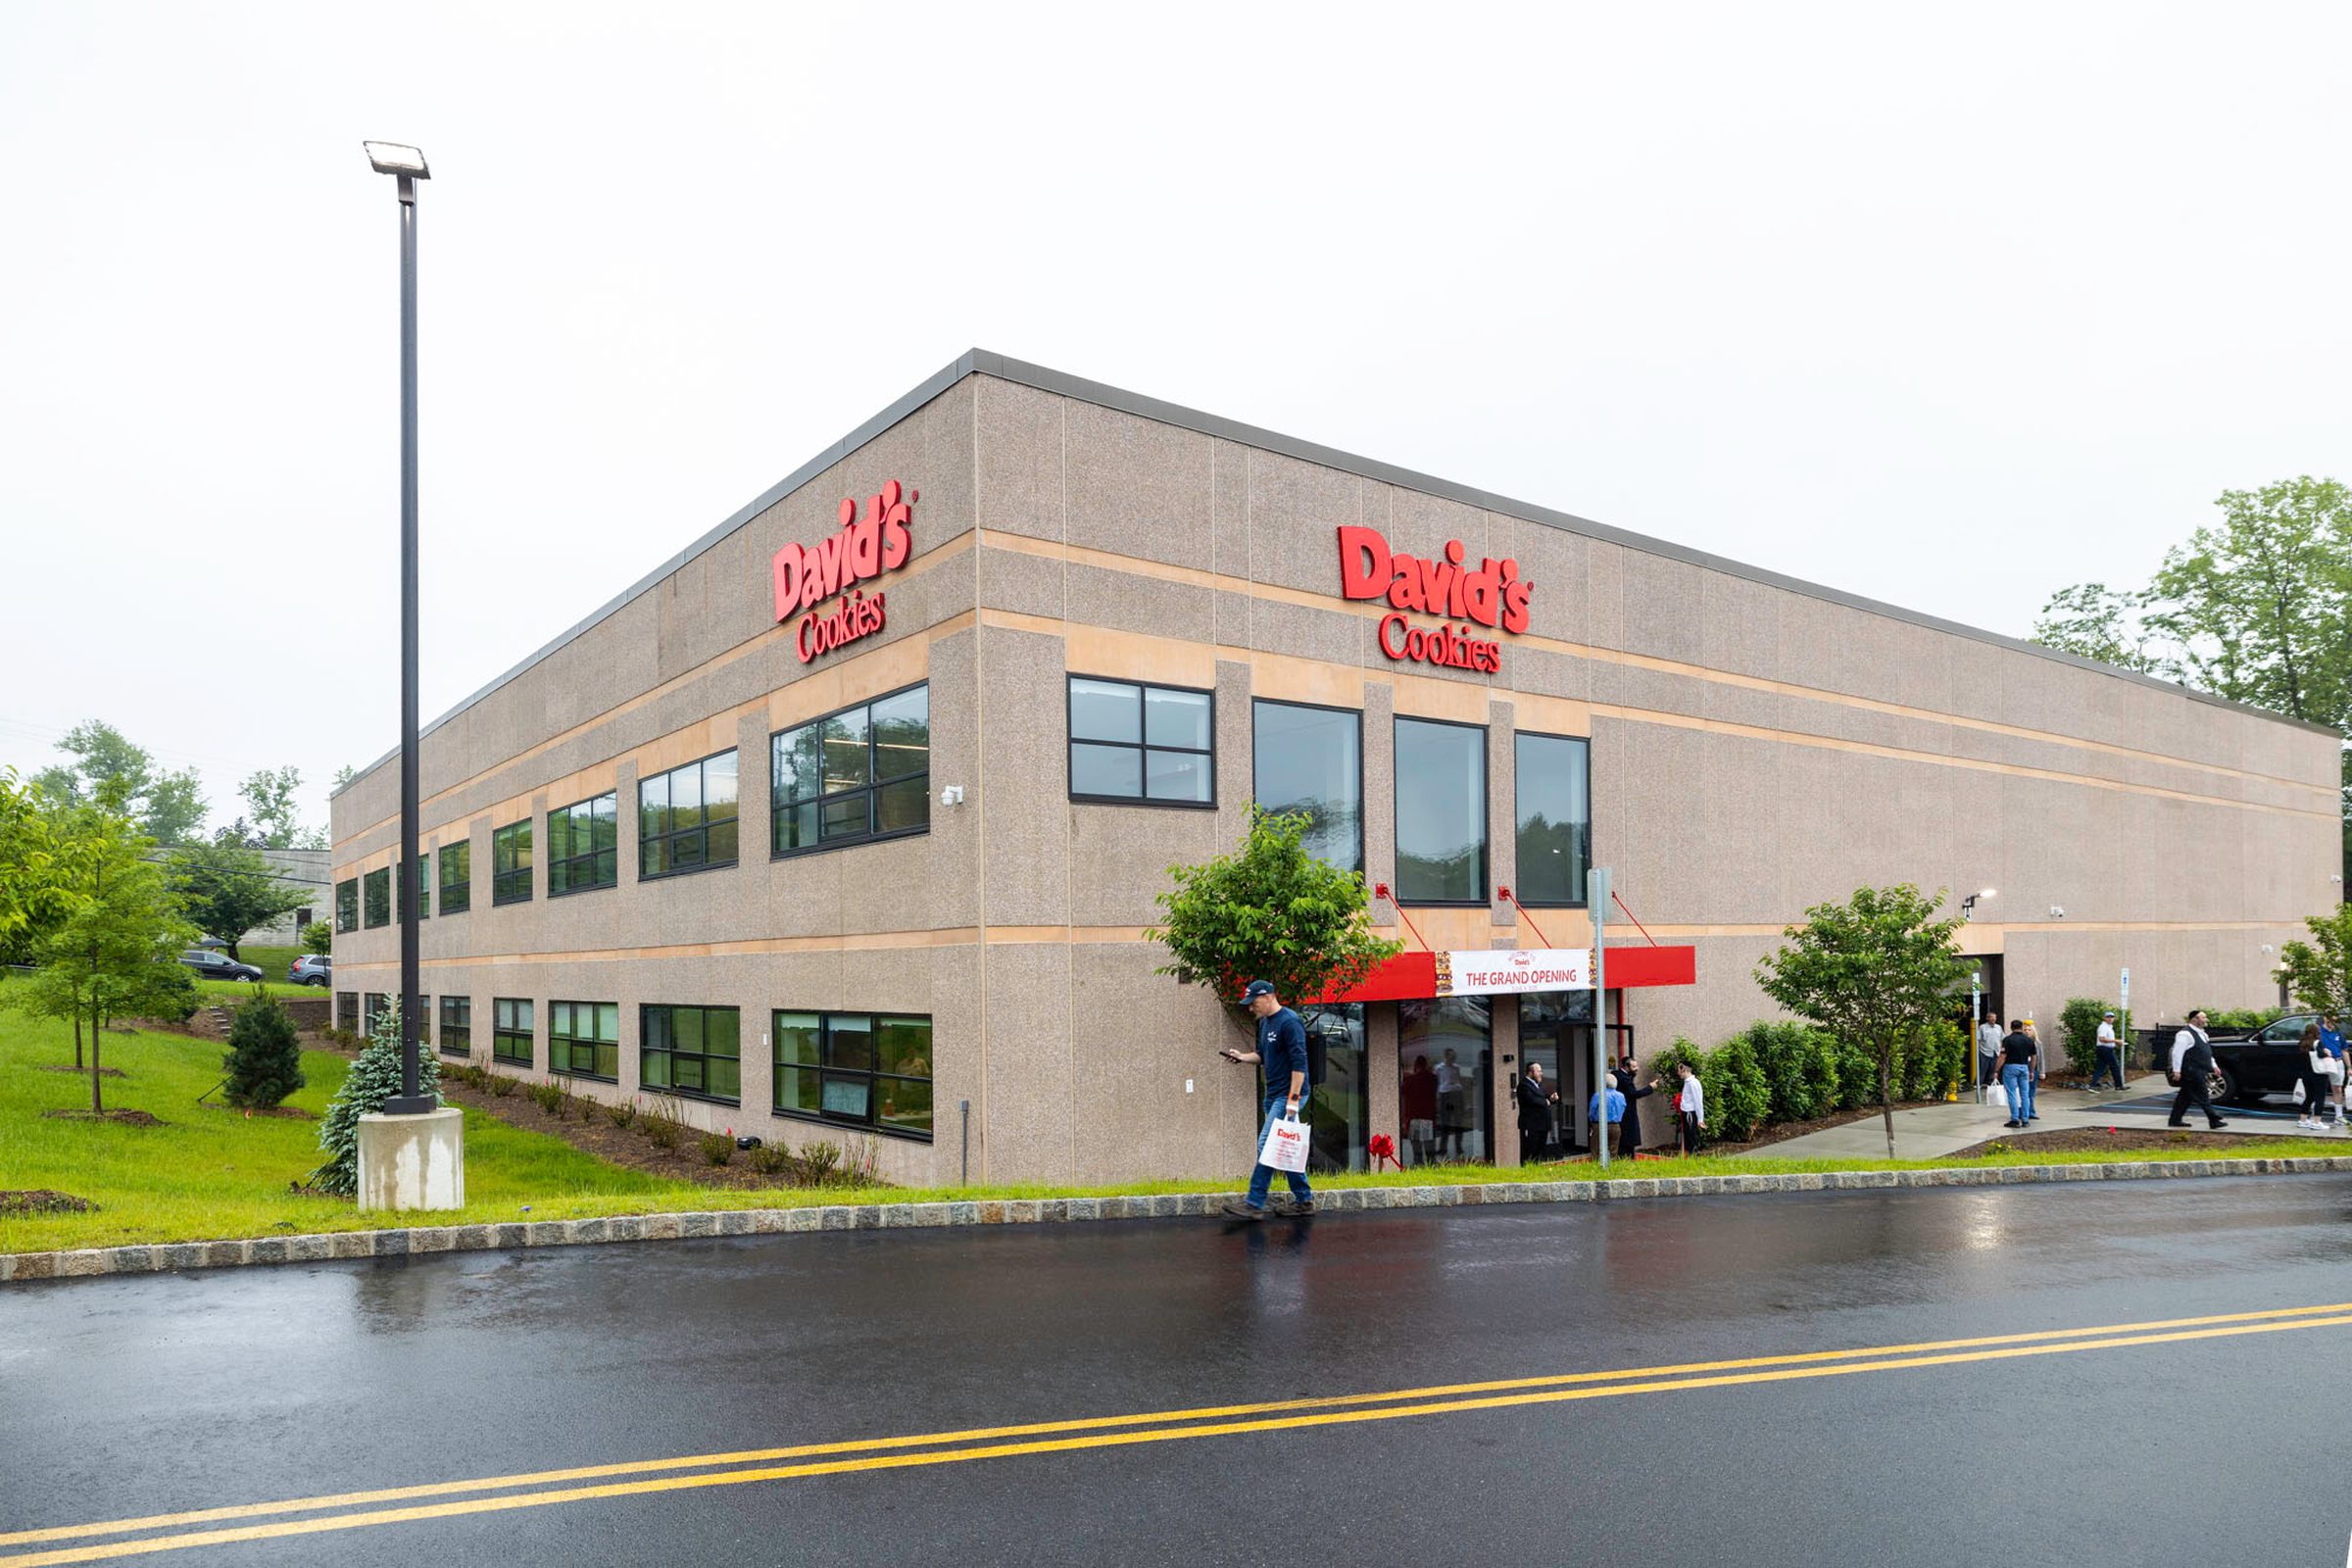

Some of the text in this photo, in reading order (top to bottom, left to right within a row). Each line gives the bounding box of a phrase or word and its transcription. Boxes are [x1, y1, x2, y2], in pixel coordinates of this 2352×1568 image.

[772, 480, 910, 622] David's
[1337, 526, 1530, 634] David's
[797, 590, 886, 663] Cookies
[1379, 612, 1500, 673] Cookies
[1466, 969, 1576, 986] THE GRAND OPENING
